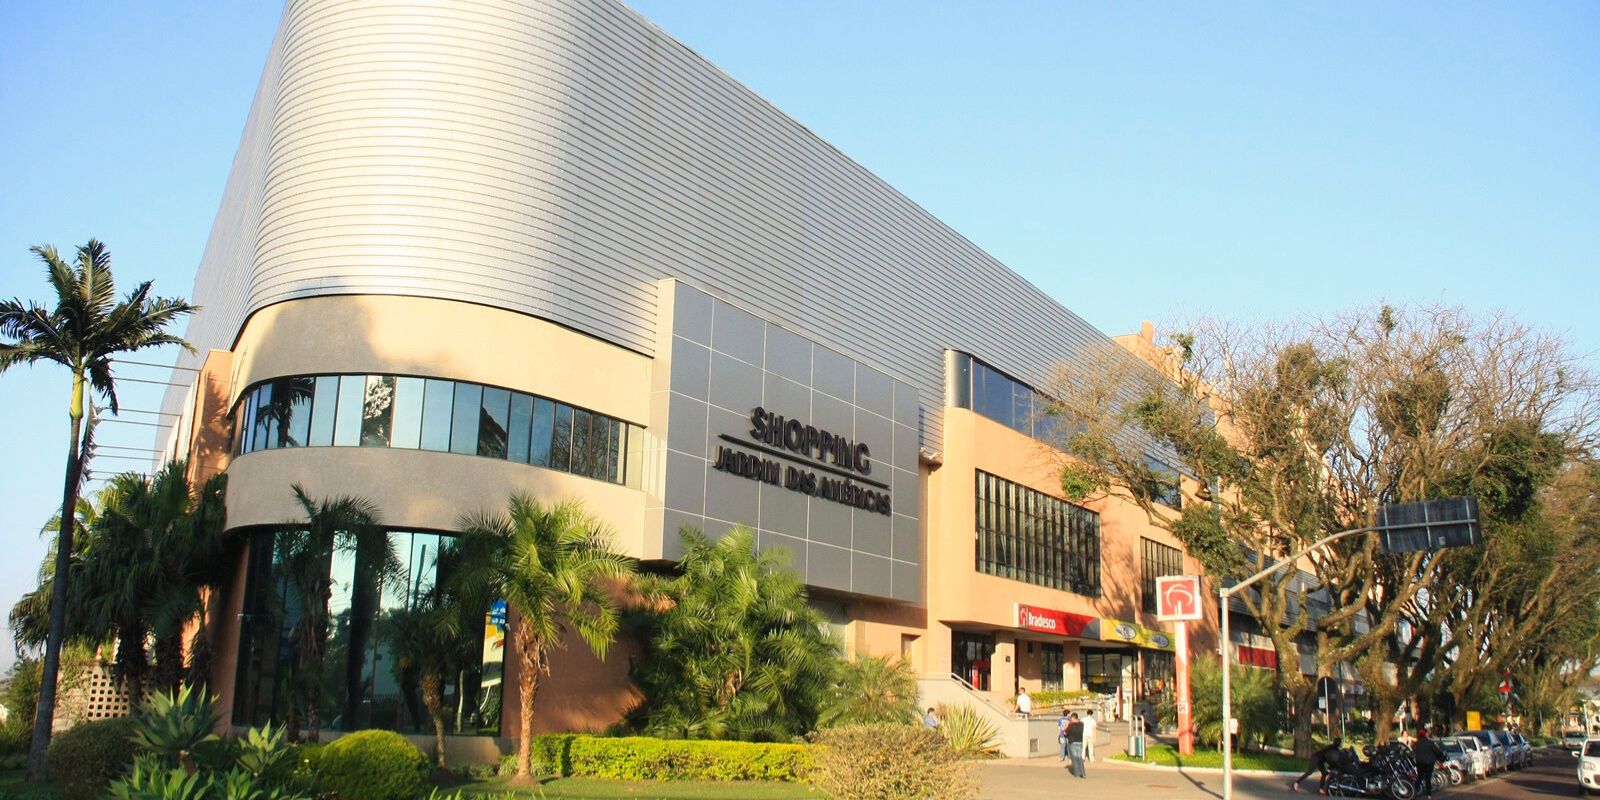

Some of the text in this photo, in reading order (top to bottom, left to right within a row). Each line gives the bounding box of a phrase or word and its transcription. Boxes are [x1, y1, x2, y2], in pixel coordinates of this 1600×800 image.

[750, 406, 871, 475] SHOPPING
[714, 446, 782, 487] JARDIM
[784, 466, 816, 497] DAS
[1028, 611, 1056, 630] Bradesco
